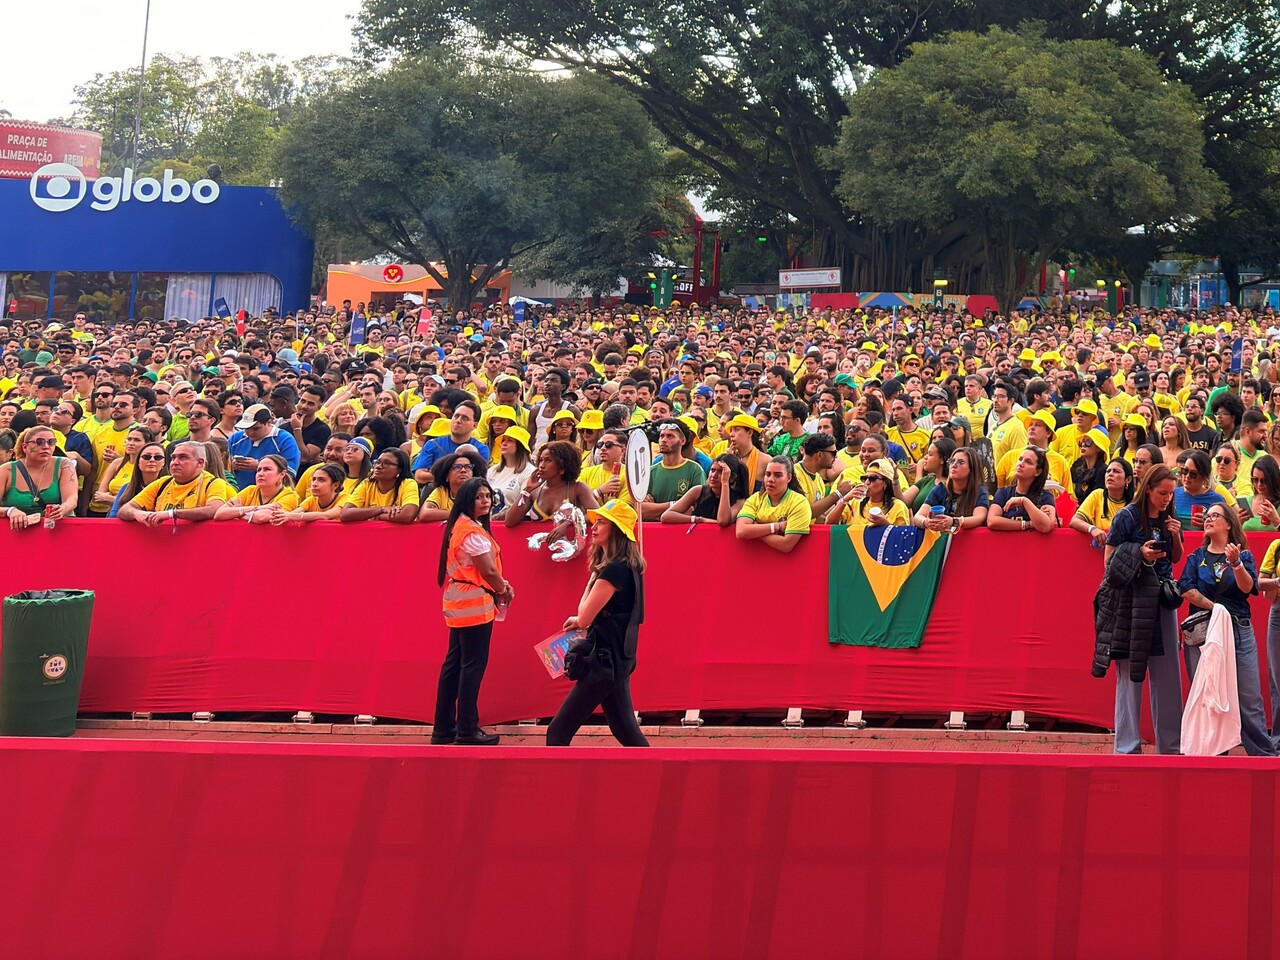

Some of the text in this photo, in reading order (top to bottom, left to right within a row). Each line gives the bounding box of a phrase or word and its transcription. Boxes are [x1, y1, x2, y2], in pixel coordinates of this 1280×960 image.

[7, 134, 48, 148] PRAÇA DE
[90, 167, 220, 212] globo
